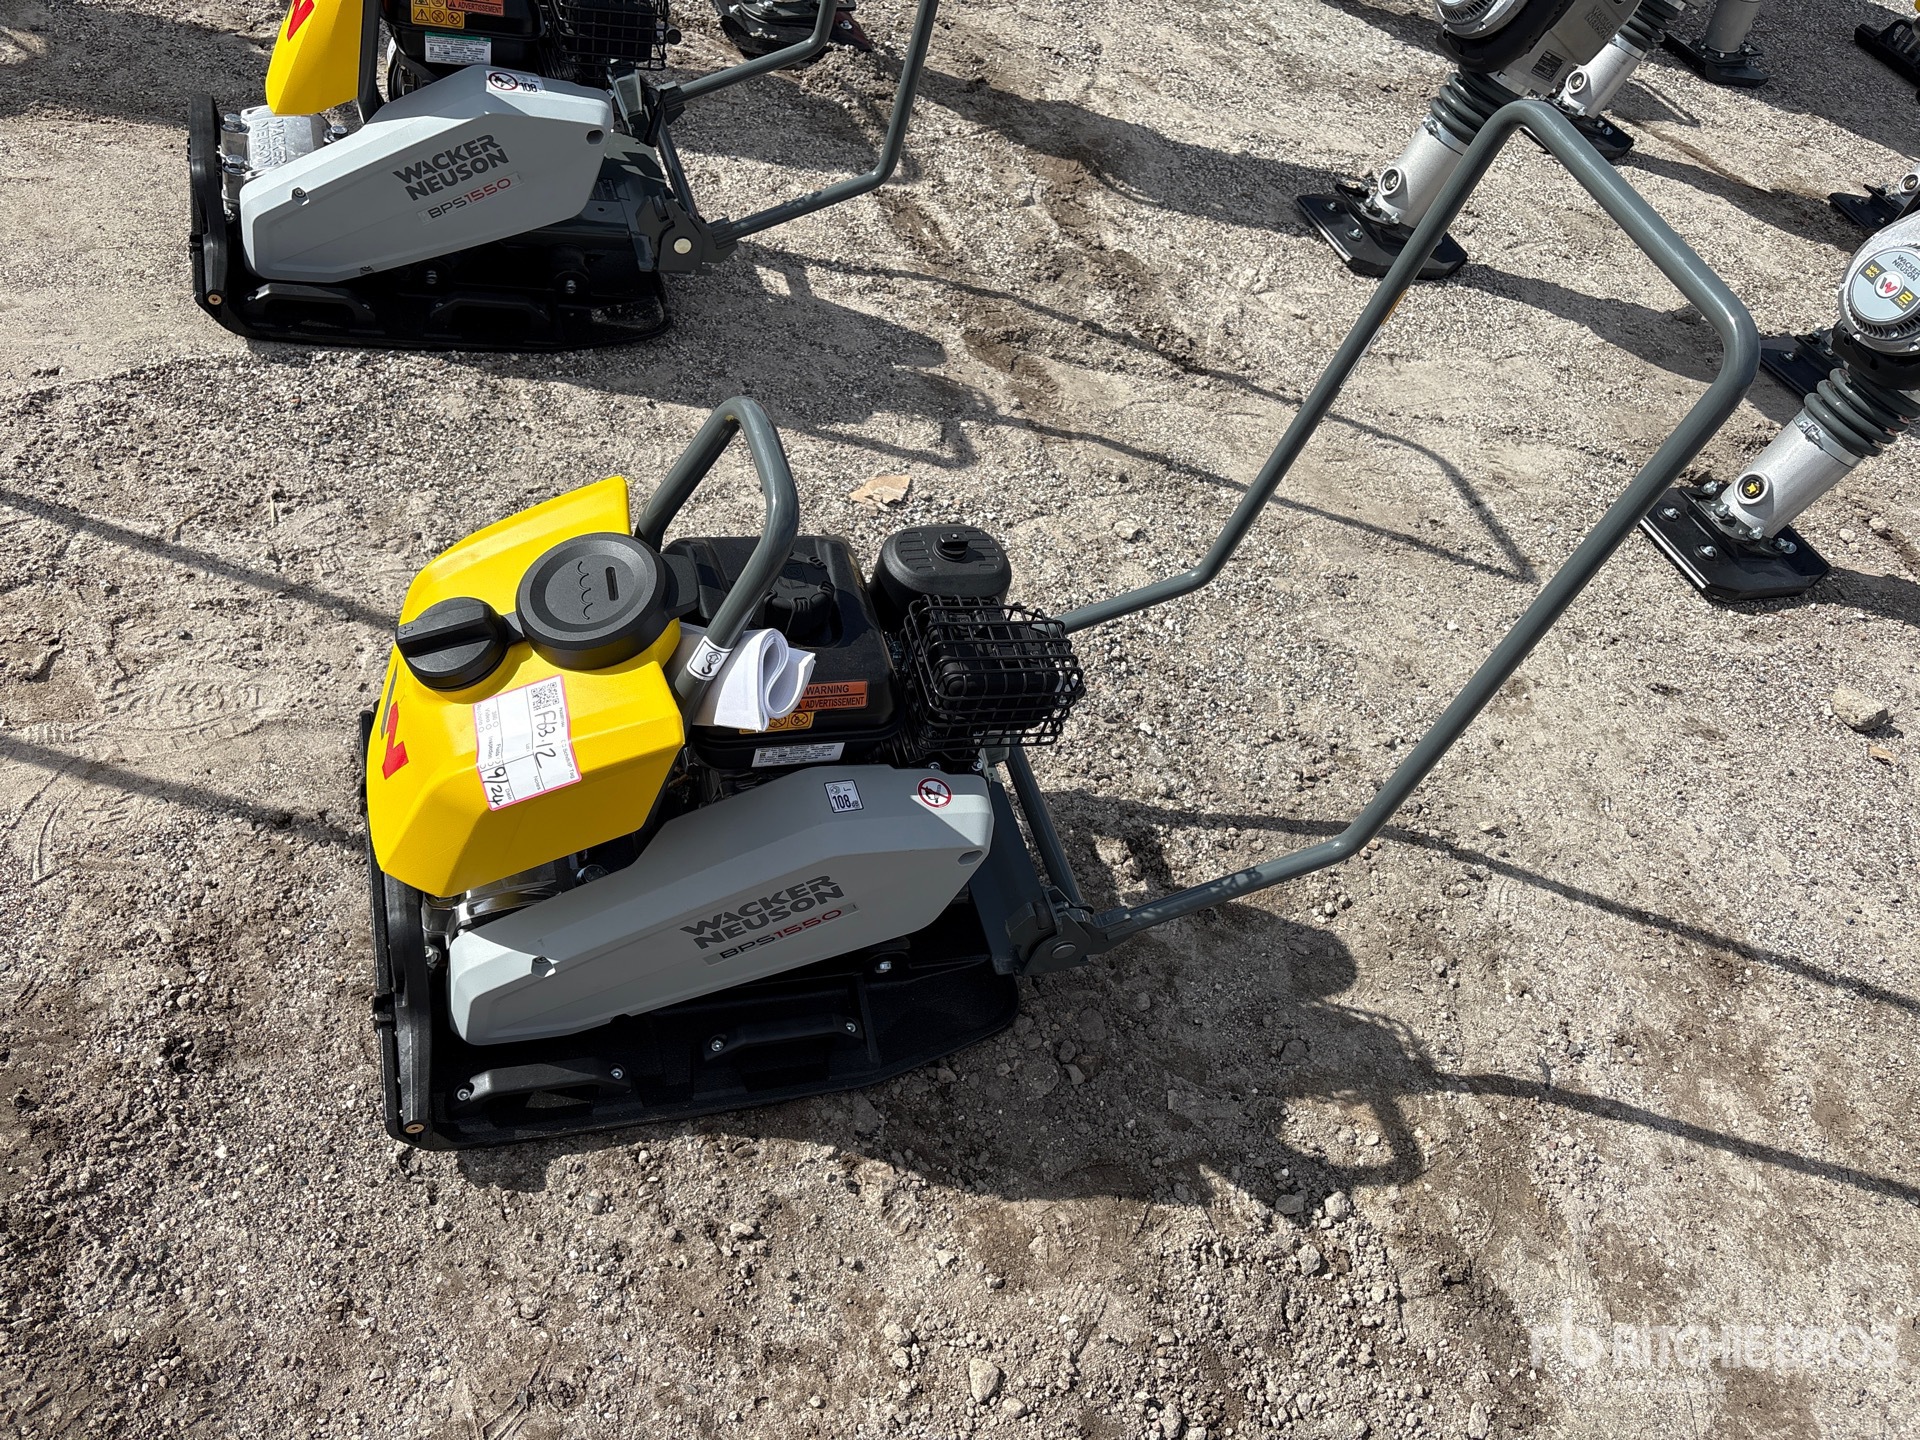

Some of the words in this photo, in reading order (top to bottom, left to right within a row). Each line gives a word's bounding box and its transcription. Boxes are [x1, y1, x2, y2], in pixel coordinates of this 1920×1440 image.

[458, 1, 503, 14] ADVERTISSEMENT
[519, 82, 538, 92] 108
[393, 134, 501, 184] WACKER
[405, 148, 510, 202] NEUSON
[428, 178, 512, 219] BPS1550
[1891, 259, 1918, 282] NEUSON
[1899, 290, 1914, 304] 2
[806, 684, 850, 696] WARNING
[805, 696, 865, 709] ADVERTISSEMENT
[832, 794, 851, 810] 108
[679, 875, 838, 936] WACKER
[693, 884, 845, 949] NEUSON
[719, 909, 842, 959] BPS1550
